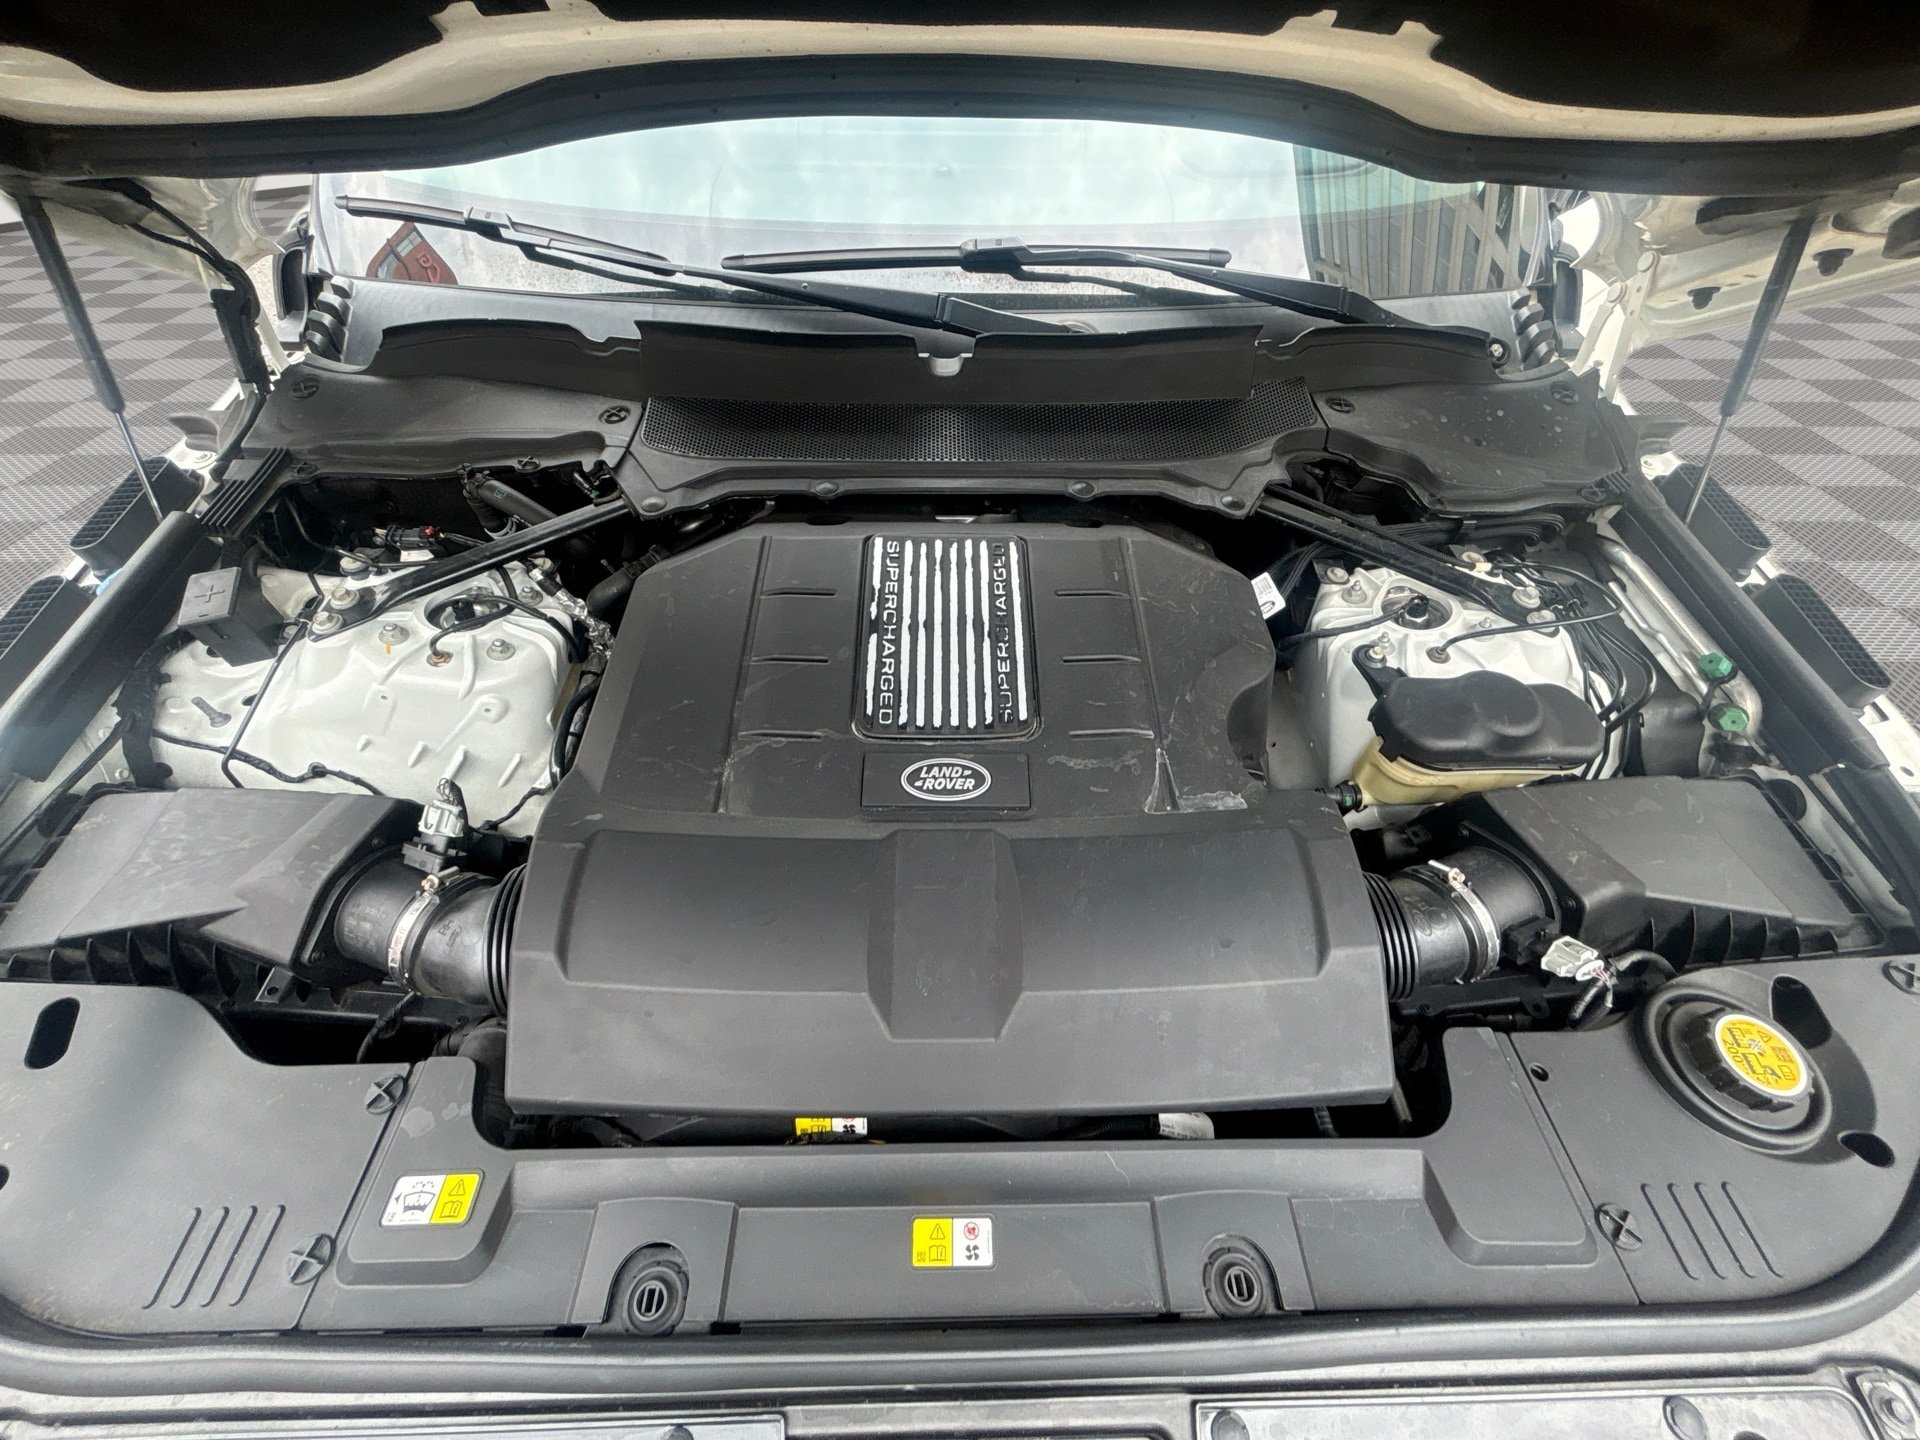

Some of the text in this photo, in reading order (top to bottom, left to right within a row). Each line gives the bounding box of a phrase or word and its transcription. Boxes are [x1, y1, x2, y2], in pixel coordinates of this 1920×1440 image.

[879, 540, 900, 725] SUPERCHARGED
[920, 766, 963, 778] LAND
[923, 778, 976, 790] ROVER
[1722, 1039, 1744, 1064] 200
